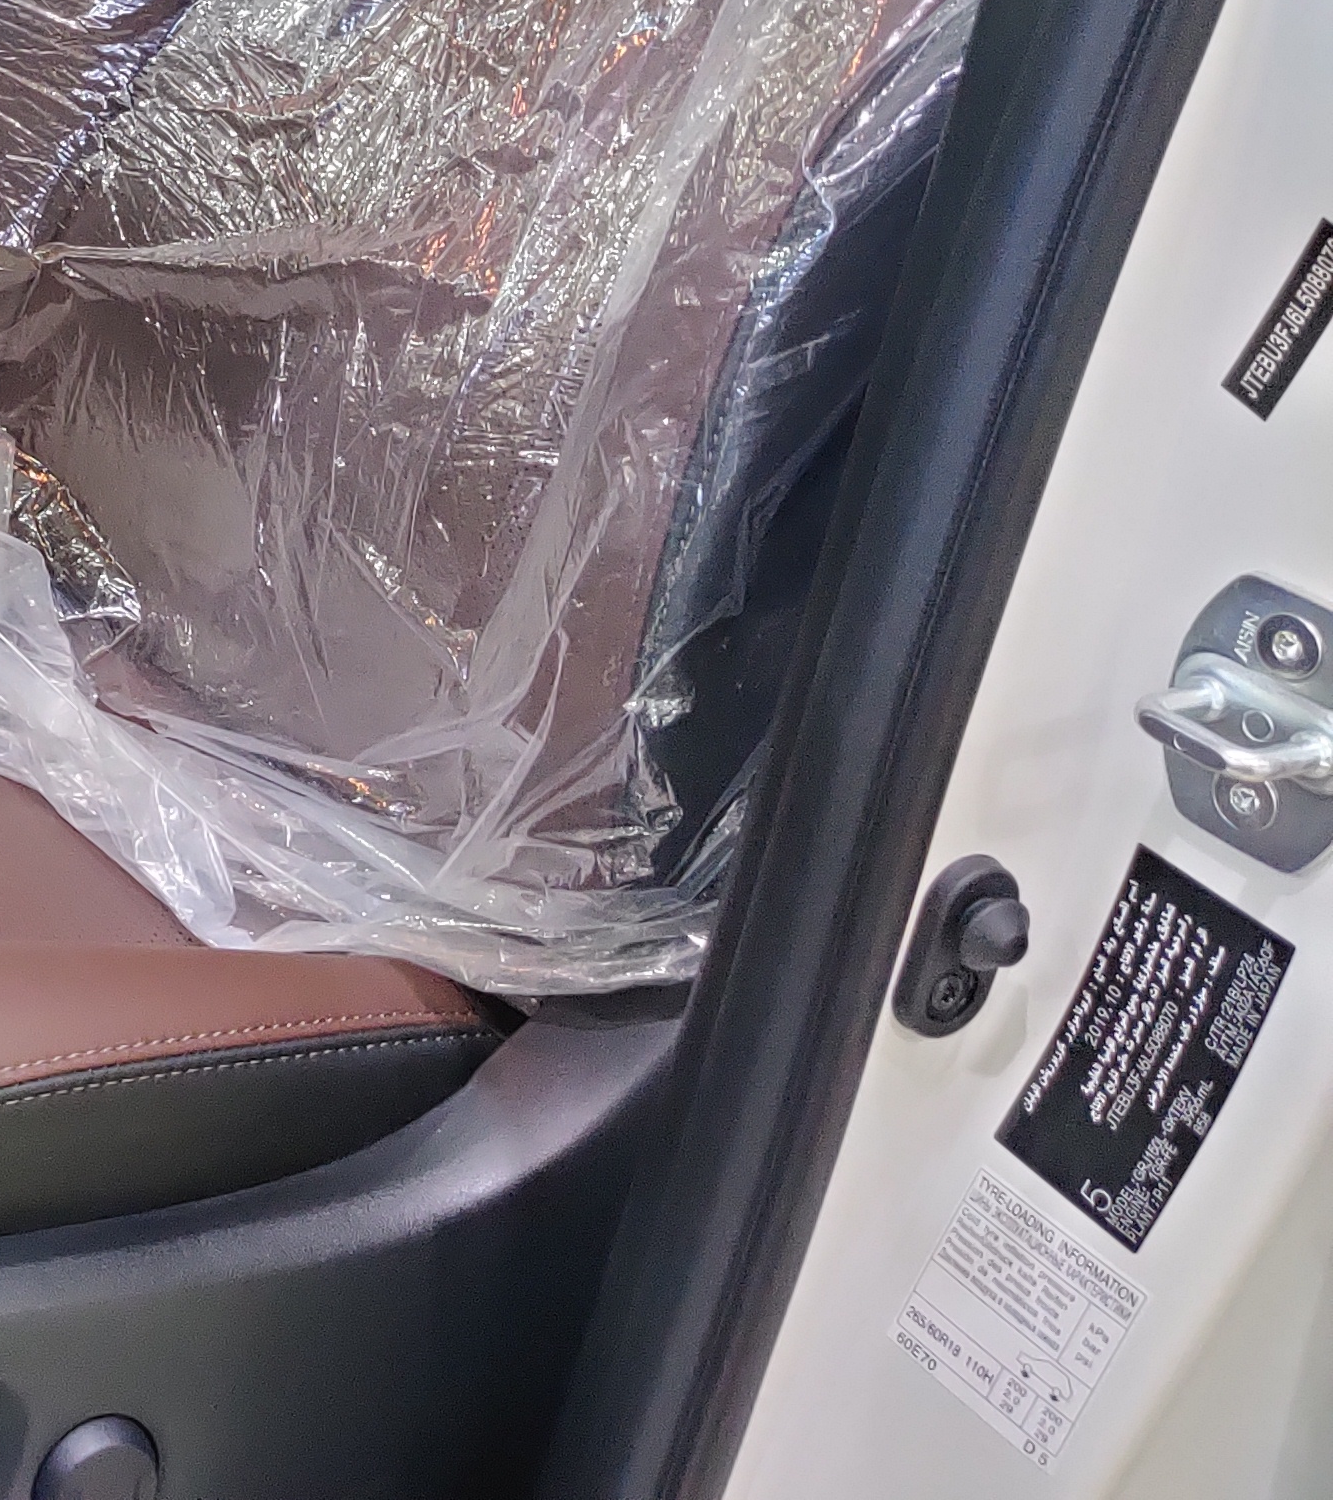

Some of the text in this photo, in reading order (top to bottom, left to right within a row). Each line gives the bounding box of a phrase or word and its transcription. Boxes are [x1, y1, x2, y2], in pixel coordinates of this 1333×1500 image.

[1233, 610, 1261, 664] AISIN
[1082, 982, 1123, 1049] 2019.10
[1225, 962, 1282, 1069] MADE IN JAPAN
[1078, 1177, 1114, 1216] 5
[976, 1175, 1057, 1244] TYRE-LOADING
[1056, 1238, 1139, 1308] INFORMATION
[894, 1329, 939, 1372] 60E70
[963, 1354, 995, 1386] 110H
